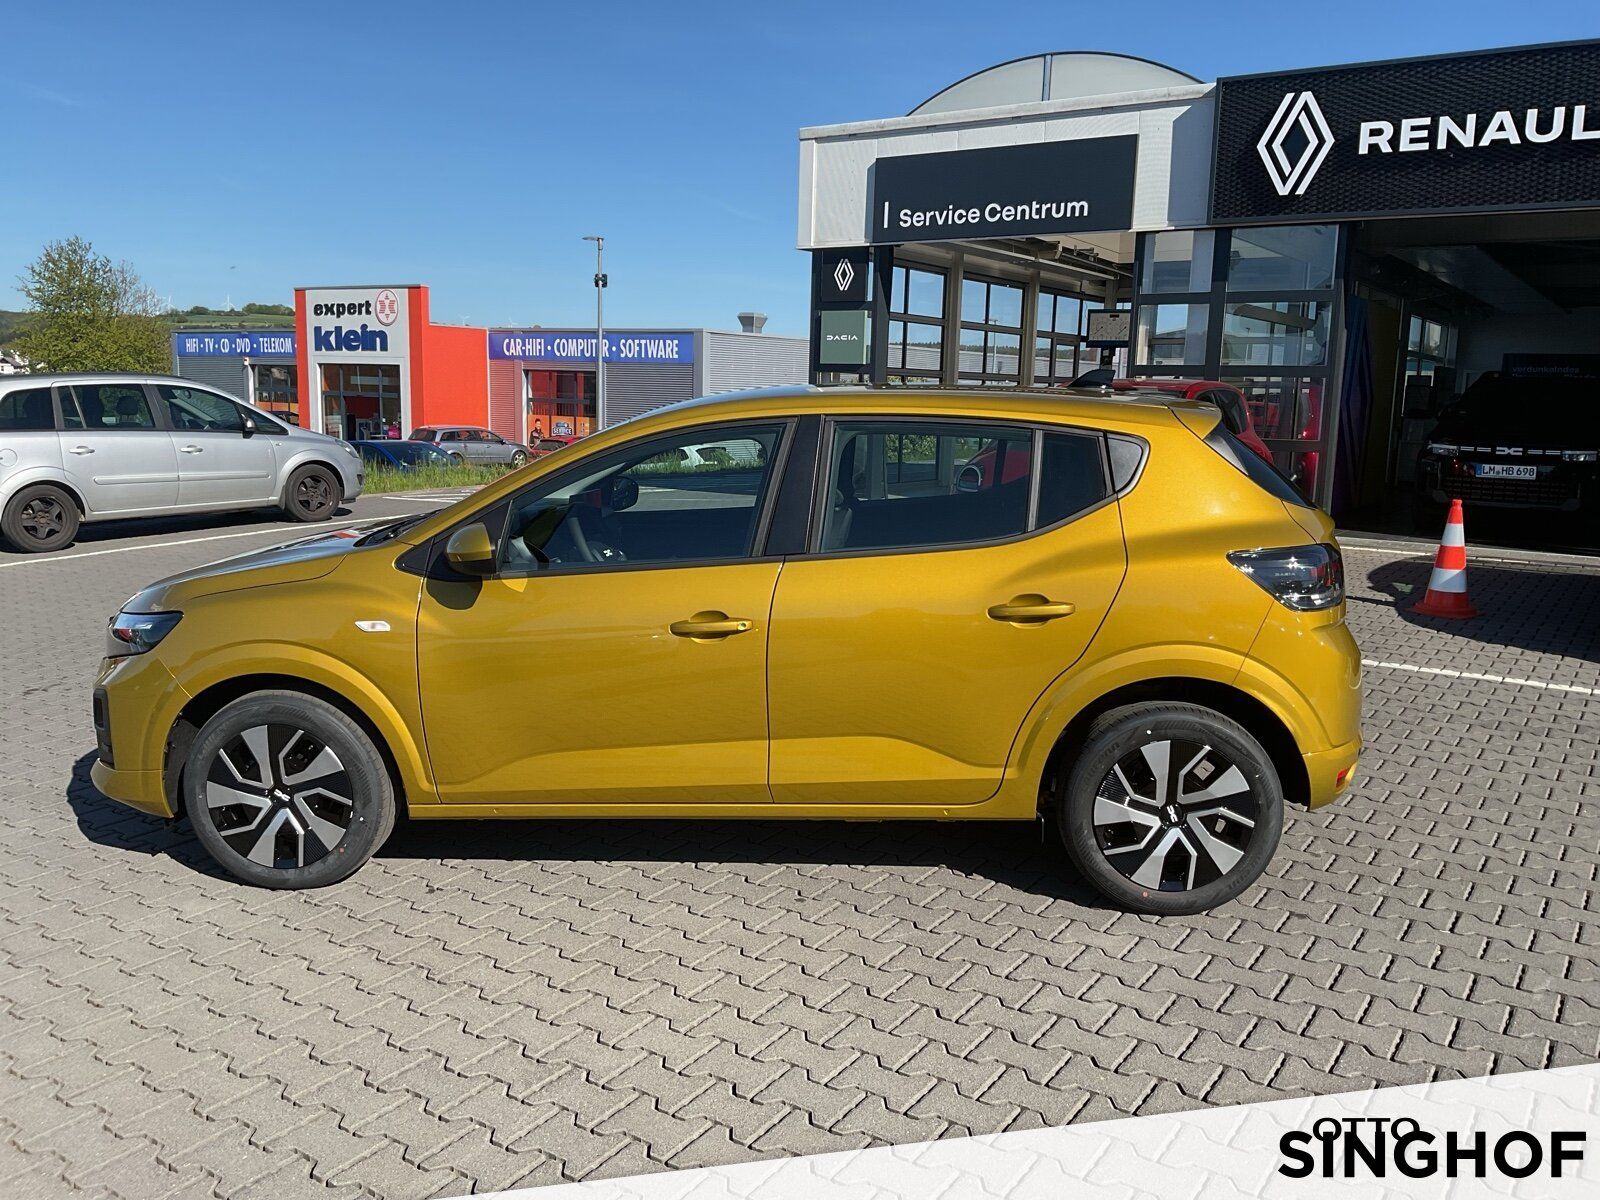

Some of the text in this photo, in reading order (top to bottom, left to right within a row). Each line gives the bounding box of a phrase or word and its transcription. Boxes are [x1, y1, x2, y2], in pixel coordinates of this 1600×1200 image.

[1358, 104, 1600, 155] RENAUL
[899, 199, 1089, 228] Service Centrum
[313, 300, 372, 319] expert
[185, 337, 292, 353] HIFI TV CD DVD TELEKOM
[314, 323, 388, 352] klein
[503, 338, 679, 358] CAR-HIFI COMPUTR SOFTWARE
[1482, 465, 1535, 477] LM HB 698
